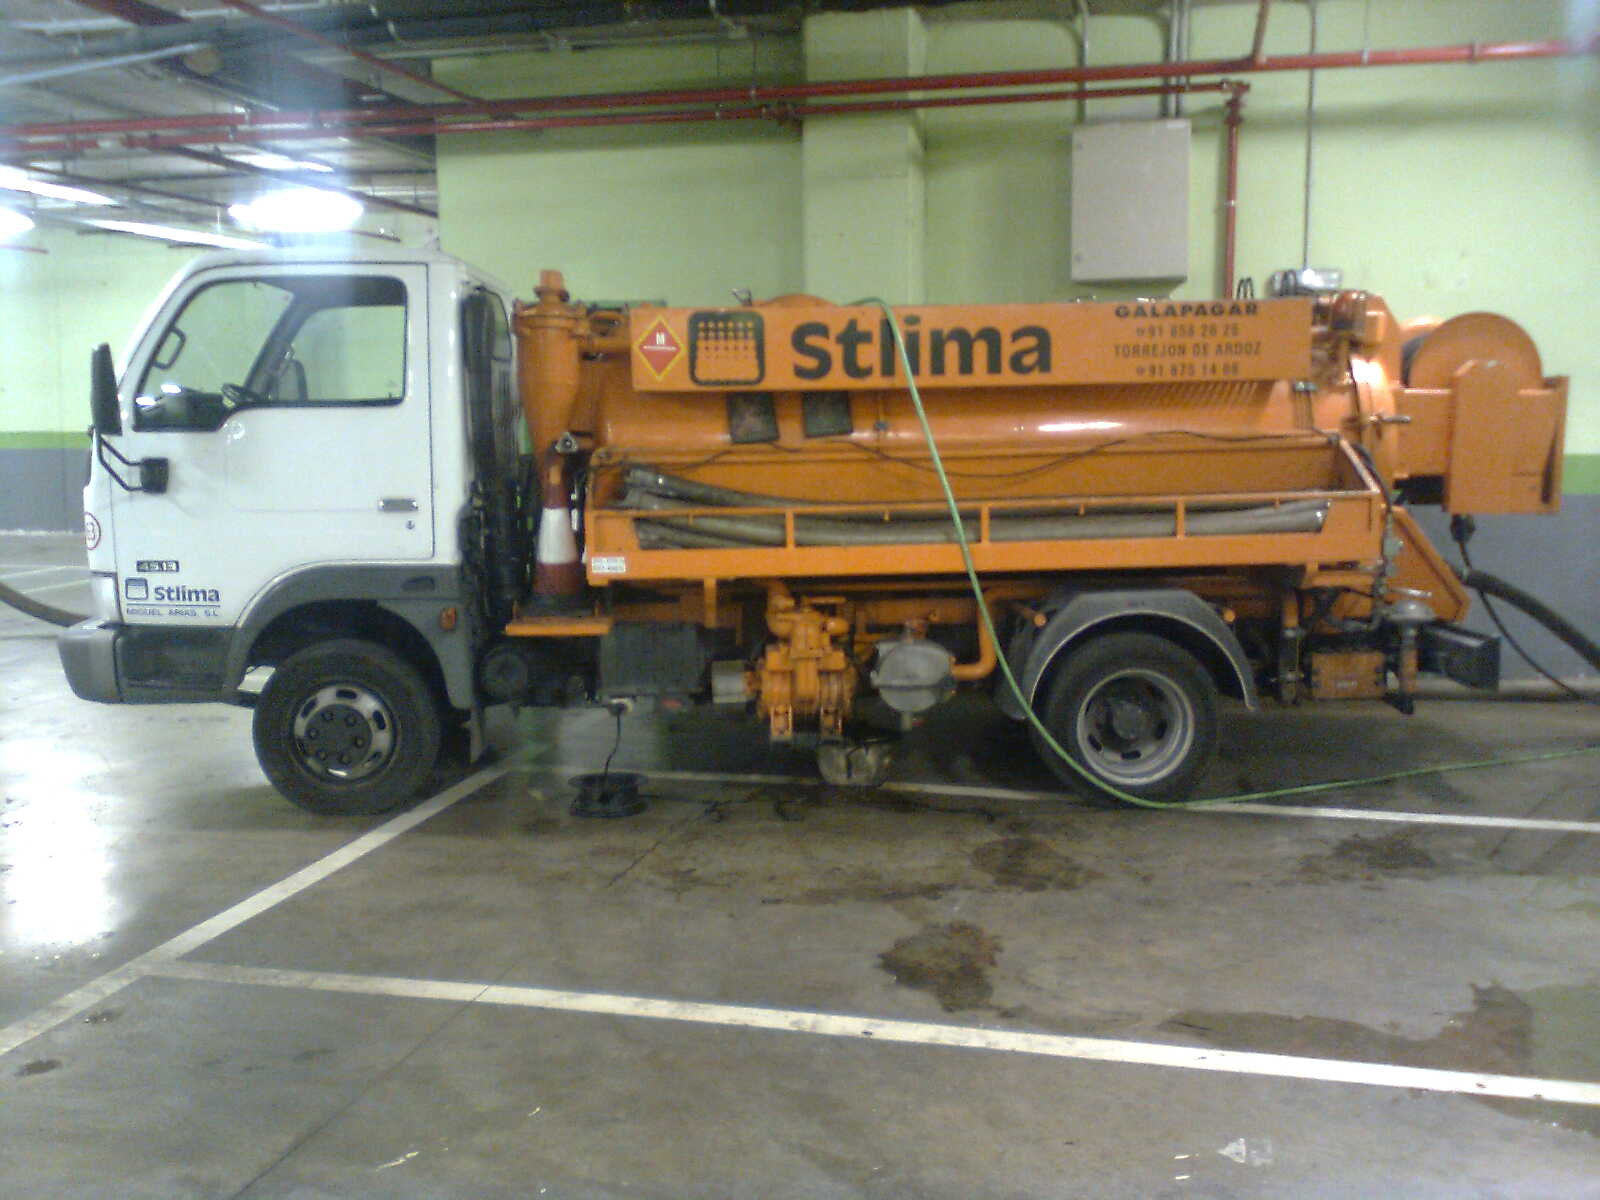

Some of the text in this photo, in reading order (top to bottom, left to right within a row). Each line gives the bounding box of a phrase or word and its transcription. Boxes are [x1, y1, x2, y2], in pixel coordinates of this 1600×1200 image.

[1114, 302, 1258, 318] GALAPAGAR
[1113, 341, 1262, 359] TORREJON DE ARDOZ
